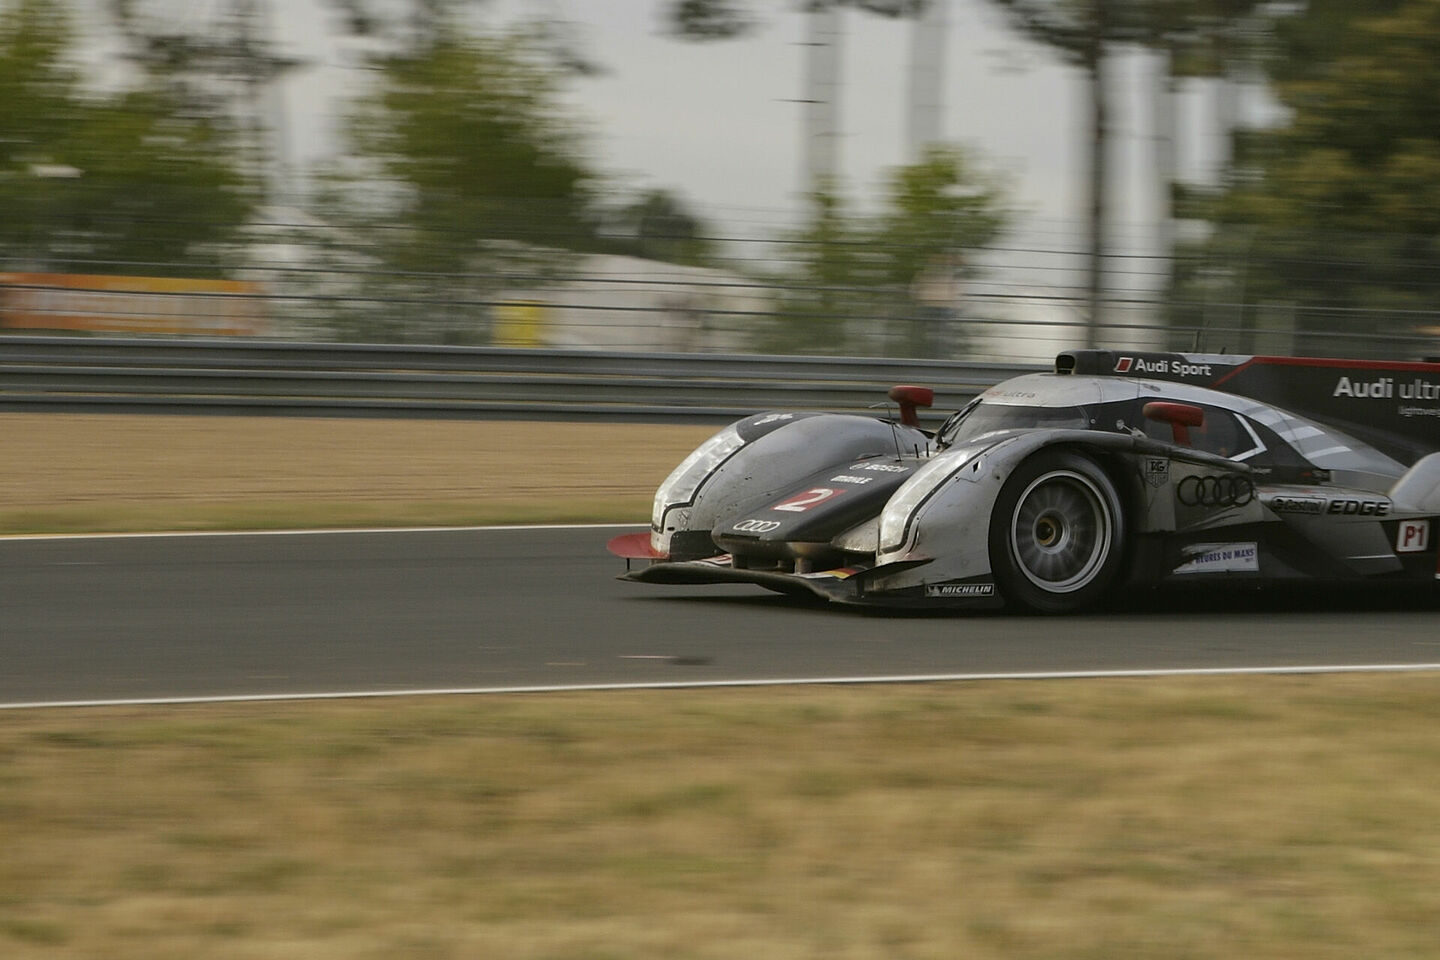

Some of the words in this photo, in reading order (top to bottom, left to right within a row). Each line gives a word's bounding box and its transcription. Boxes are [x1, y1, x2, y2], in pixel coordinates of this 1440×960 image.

[1134, 359, 1168, 373] Audi
[1171, 361, 1212, 377] Sport
[1332, 376, 1394, 398] Audi
[773, 488, 833, 512] 2
[1327, 499, 1390, 516] EDGE
[1403, 525, 1425, 547] P1
[1222, 550, 1233, 561] DU
[1234, 548, 1254, 559] MANS
[941, 585, 992, 594] MICHELIN
